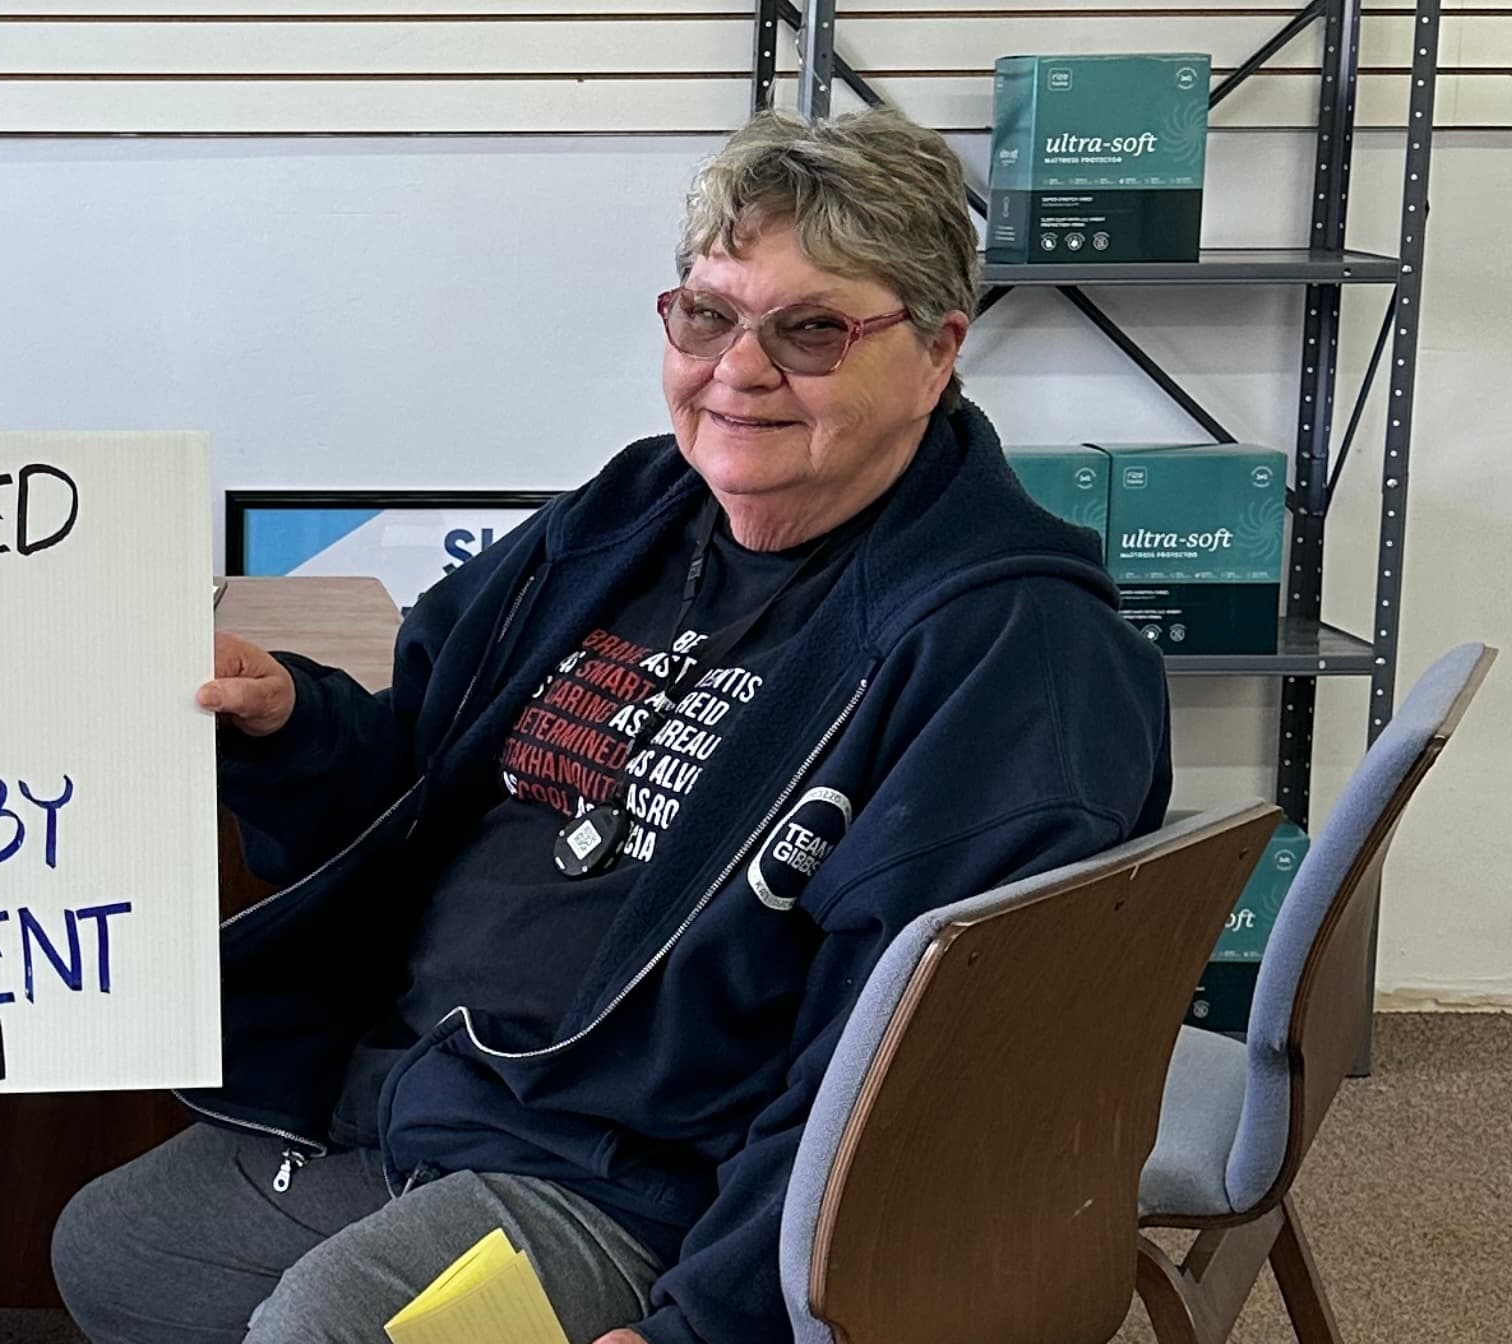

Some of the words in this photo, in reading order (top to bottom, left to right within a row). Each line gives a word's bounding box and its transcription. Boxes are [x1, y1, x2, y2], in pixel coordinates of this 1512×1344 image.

[1046, 132, 1158, 156] ultra-soft
[1122, 528, 1234, 552] ultra-soft
[672, 630, 708, 654] BE
[575, 659, 656, 703] SMART
[675, 691, 730, 726] REID
[608, 705, 649, 738] AS
[517, 782, 572, 817] COOL
[626, 783, 651, 819] AS
